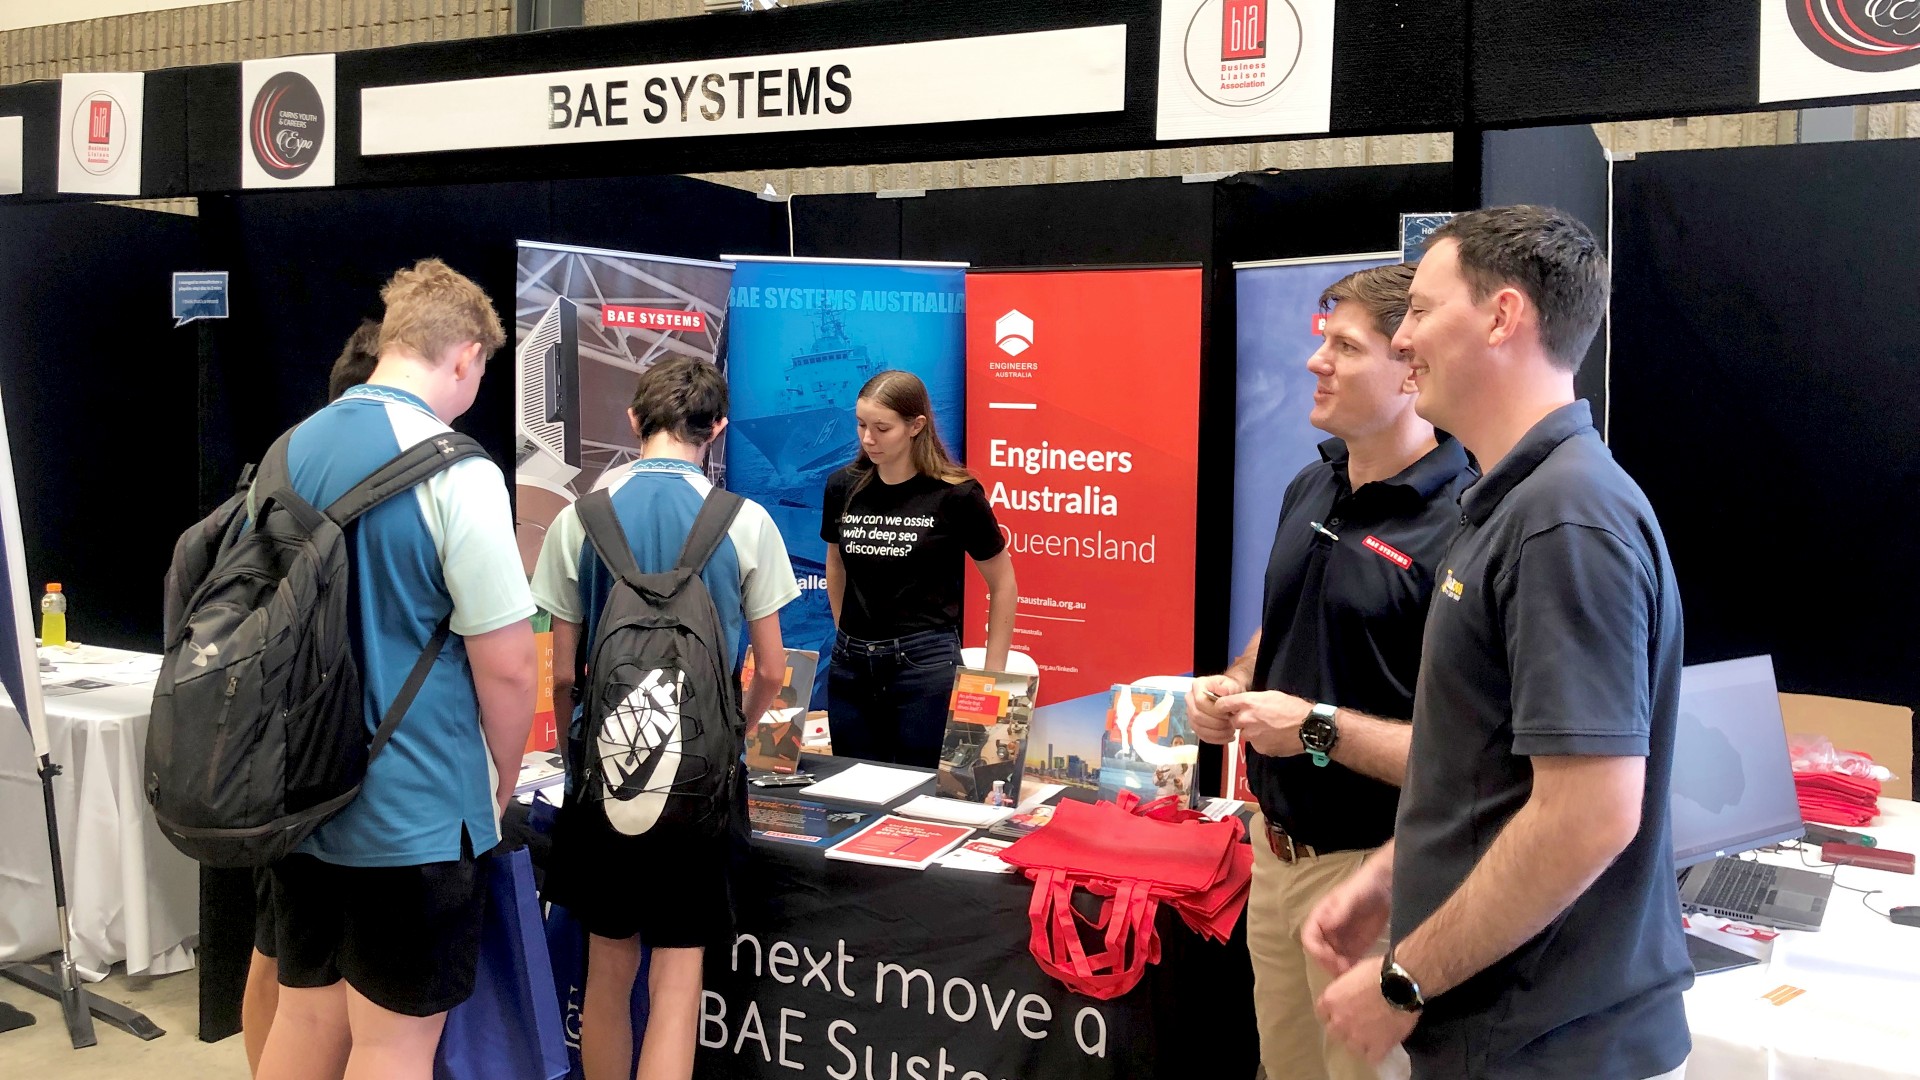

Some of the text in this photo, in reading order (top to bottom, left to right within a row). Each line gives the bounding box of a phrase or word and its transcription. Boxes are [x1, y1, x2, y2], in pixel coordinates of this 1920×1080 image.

[1220, 71, 1266, 80] Liaison
[1221, 62, 1266, 72] Business
[1220, 80, 1265, 90] Association
[548, 64, 853, 129] BAE SYSTEMS
[279, 110, 318, 122] CAIRNS YOUTH
[284, 119, 307, 128] CAREERS
[728, 286, 966, 314] BAE SYSTEMS AUSTRALIA
[607, 309, 701, 327] BAE SYSTEMS
[989, 362, 1038, 370] ENGINEERS
[989, 439, 1133, 475] Engineers
[989, 481, 1118, 516] Australia
[842, 511, 935, 528] How can we assist
[843, 527, 918, 544] with deep sea
[845, 541, 912, 556] discoveries?
[1366, 538, 1408, 565] BAE SYSTEMS
[797, 575, 828, 590] alle
[731, 933, 856, 997] next
[876, 961, 1052, 1039] move
[699, 989, 805, 1070] BAE
